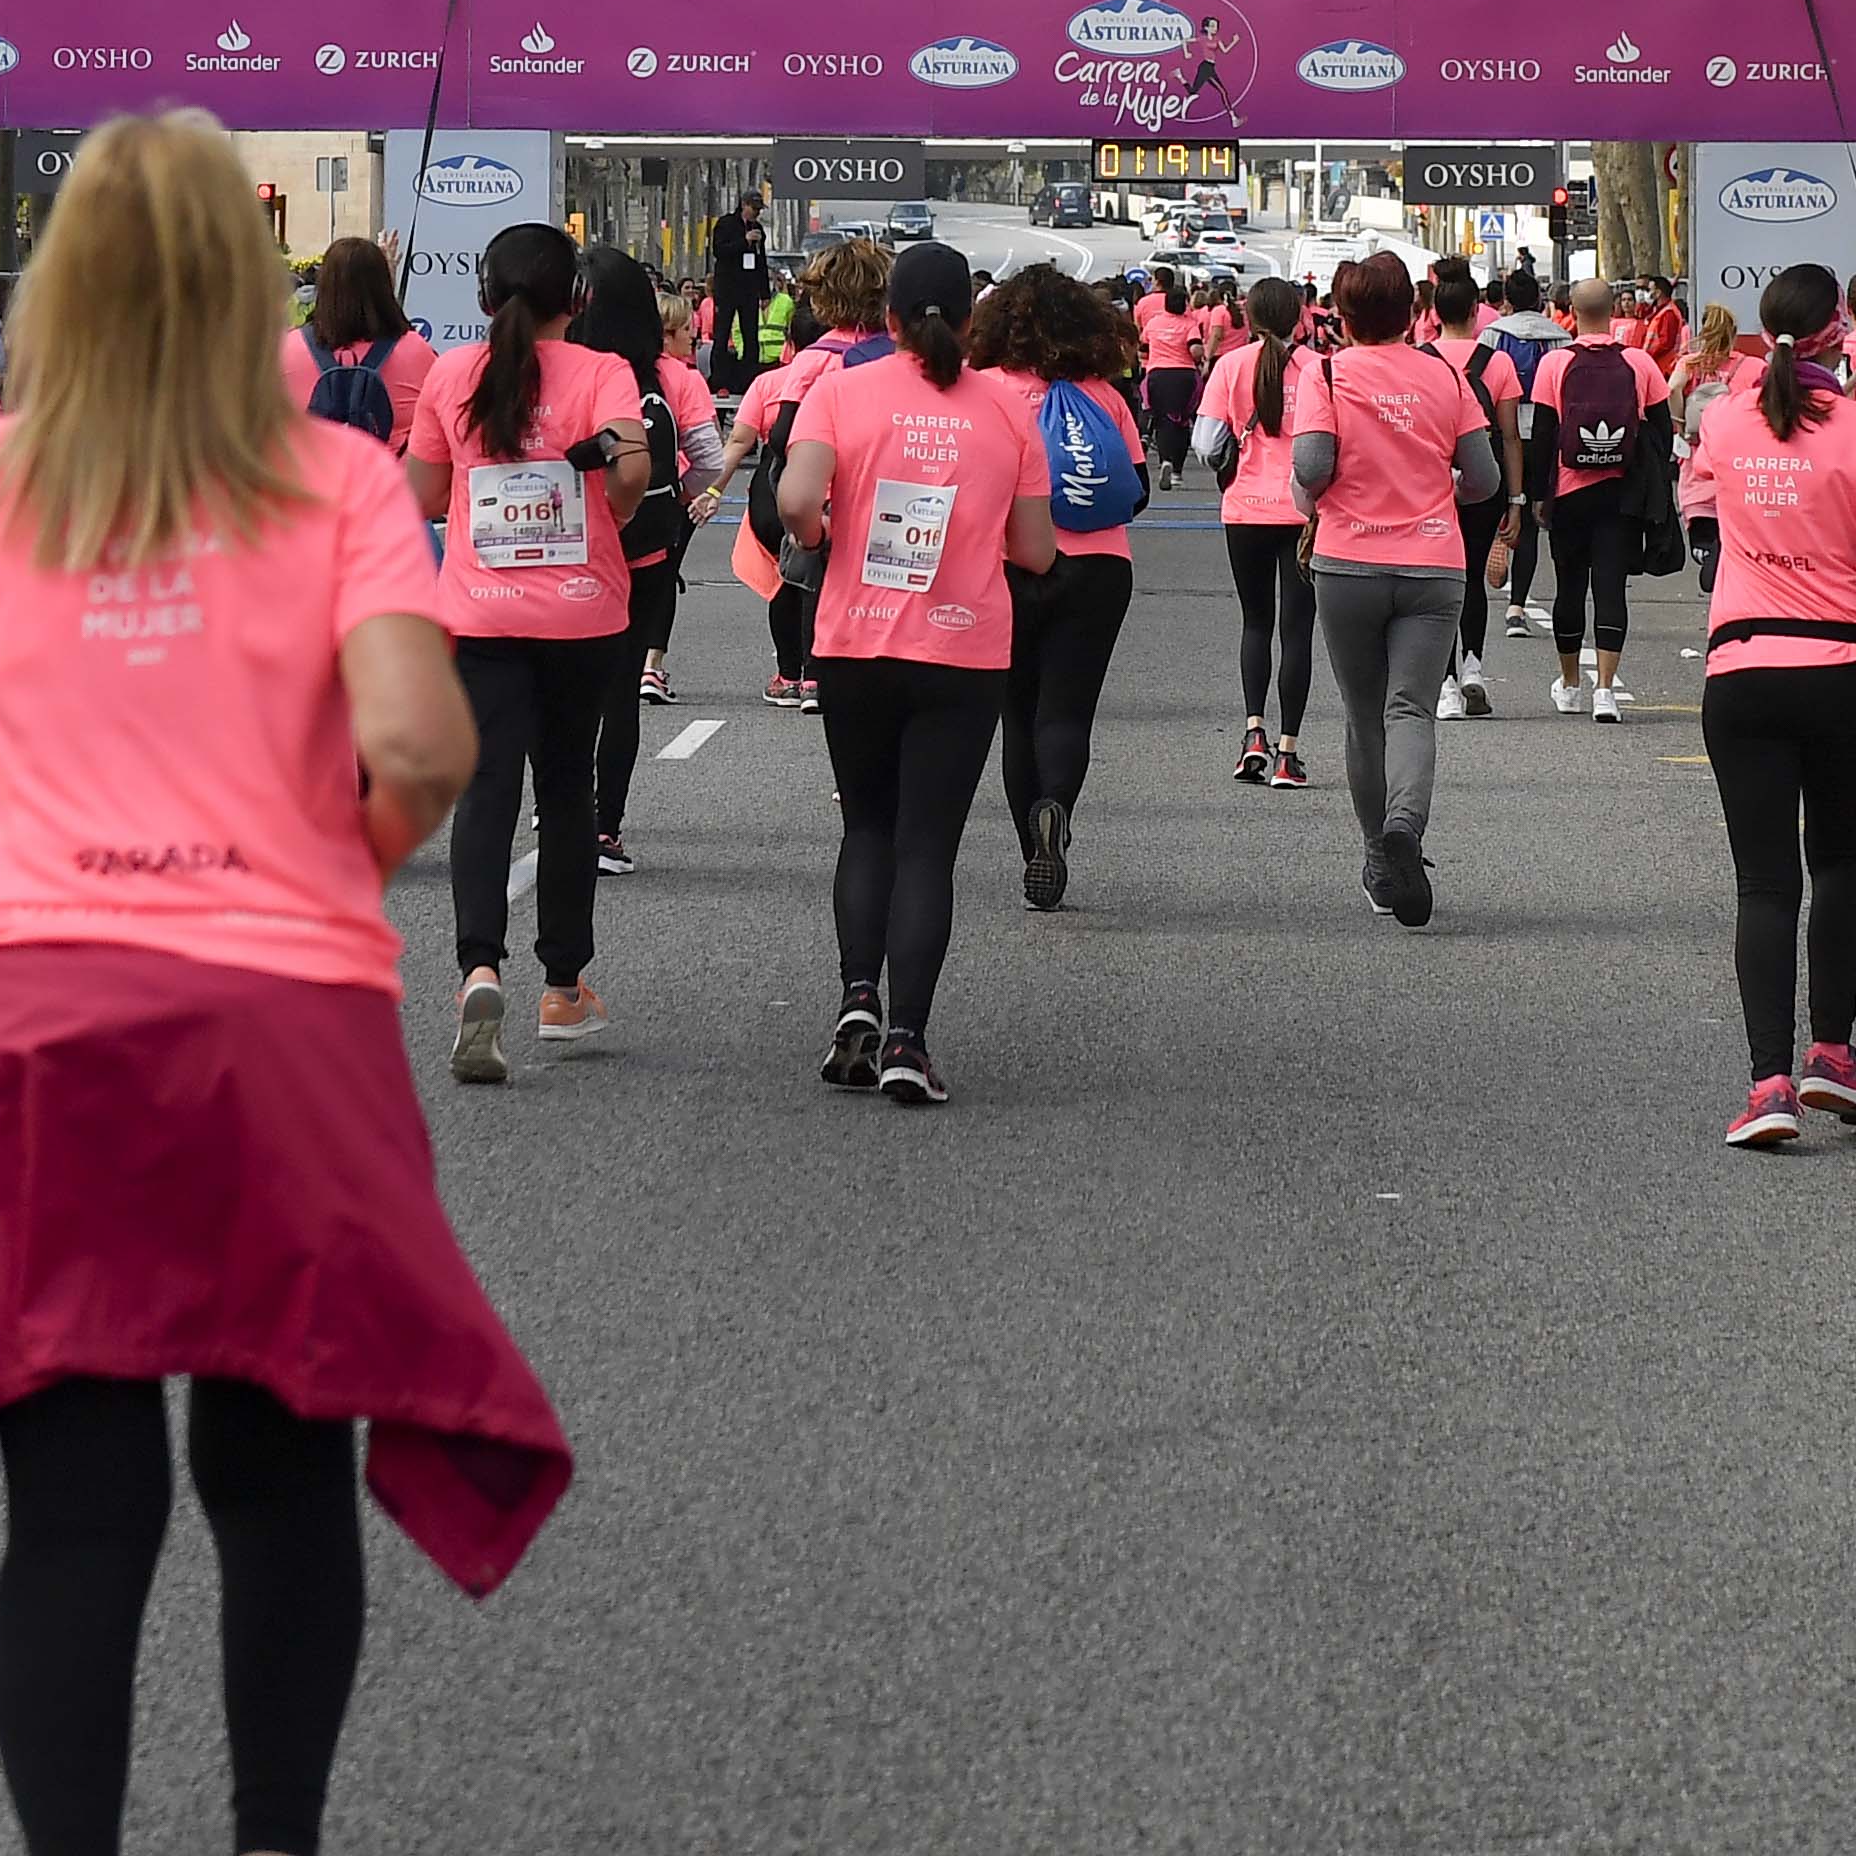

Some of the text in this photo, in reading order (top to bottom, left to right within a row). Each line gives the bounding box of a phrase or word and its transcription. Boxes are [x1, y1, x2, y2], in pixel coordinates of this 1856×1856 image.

[1076, 17, 1185, 41] ASTURIANA
[53, 47, 152, 70] OYSHO
[185, 52, 281, 73] Santander
[354, 50, 439, 70] ZURICH
[489, 54, 585, 75] Santander
[666, 54, 750, 73] ZURICH
[783, 54, 883, 77] OYSHO
[917, 54, 1010, 76] ASTURIANA
[1054, 51, 1160, 84] Carrera
[1305, 57, 1397, 79] ASTURIANA
[1440, 58, 1541, 82] OYSHO
[1574, 65, 1672, 85] Santander
[1746, 62, 1829, 81] ZURICH
[1079, 83, 1119, 106] de la
[1114, 80, 1199, 132] Mujer
[793, 157, 905, 185] OYSHO
[1423, 162, 1535, 188] OYSHO
[422, 172, 515, 194] ASTURIANA
[1728, 187, 1828, 209] ASTURIANA
[891, 412, 974, 432] CARRERA
[906, 431, 957, 446] DE LA
[903, 446, 960, 463] MUJER
[1576, 452, 1624, 464] adidas
[1732, 456, 1814, 472] CARRERA
[1746, 474, 1797, 489] DE LA
[1744, 491, 1799, 506] MUJER
[503, 502, 551, 522] 016
[87, 569, 196, 604] DE LA
[470, 585, 525, 600] OYSHO
[80, 604, 204, 639] MUJER
[847, 606, 899, 621] OYSHO
